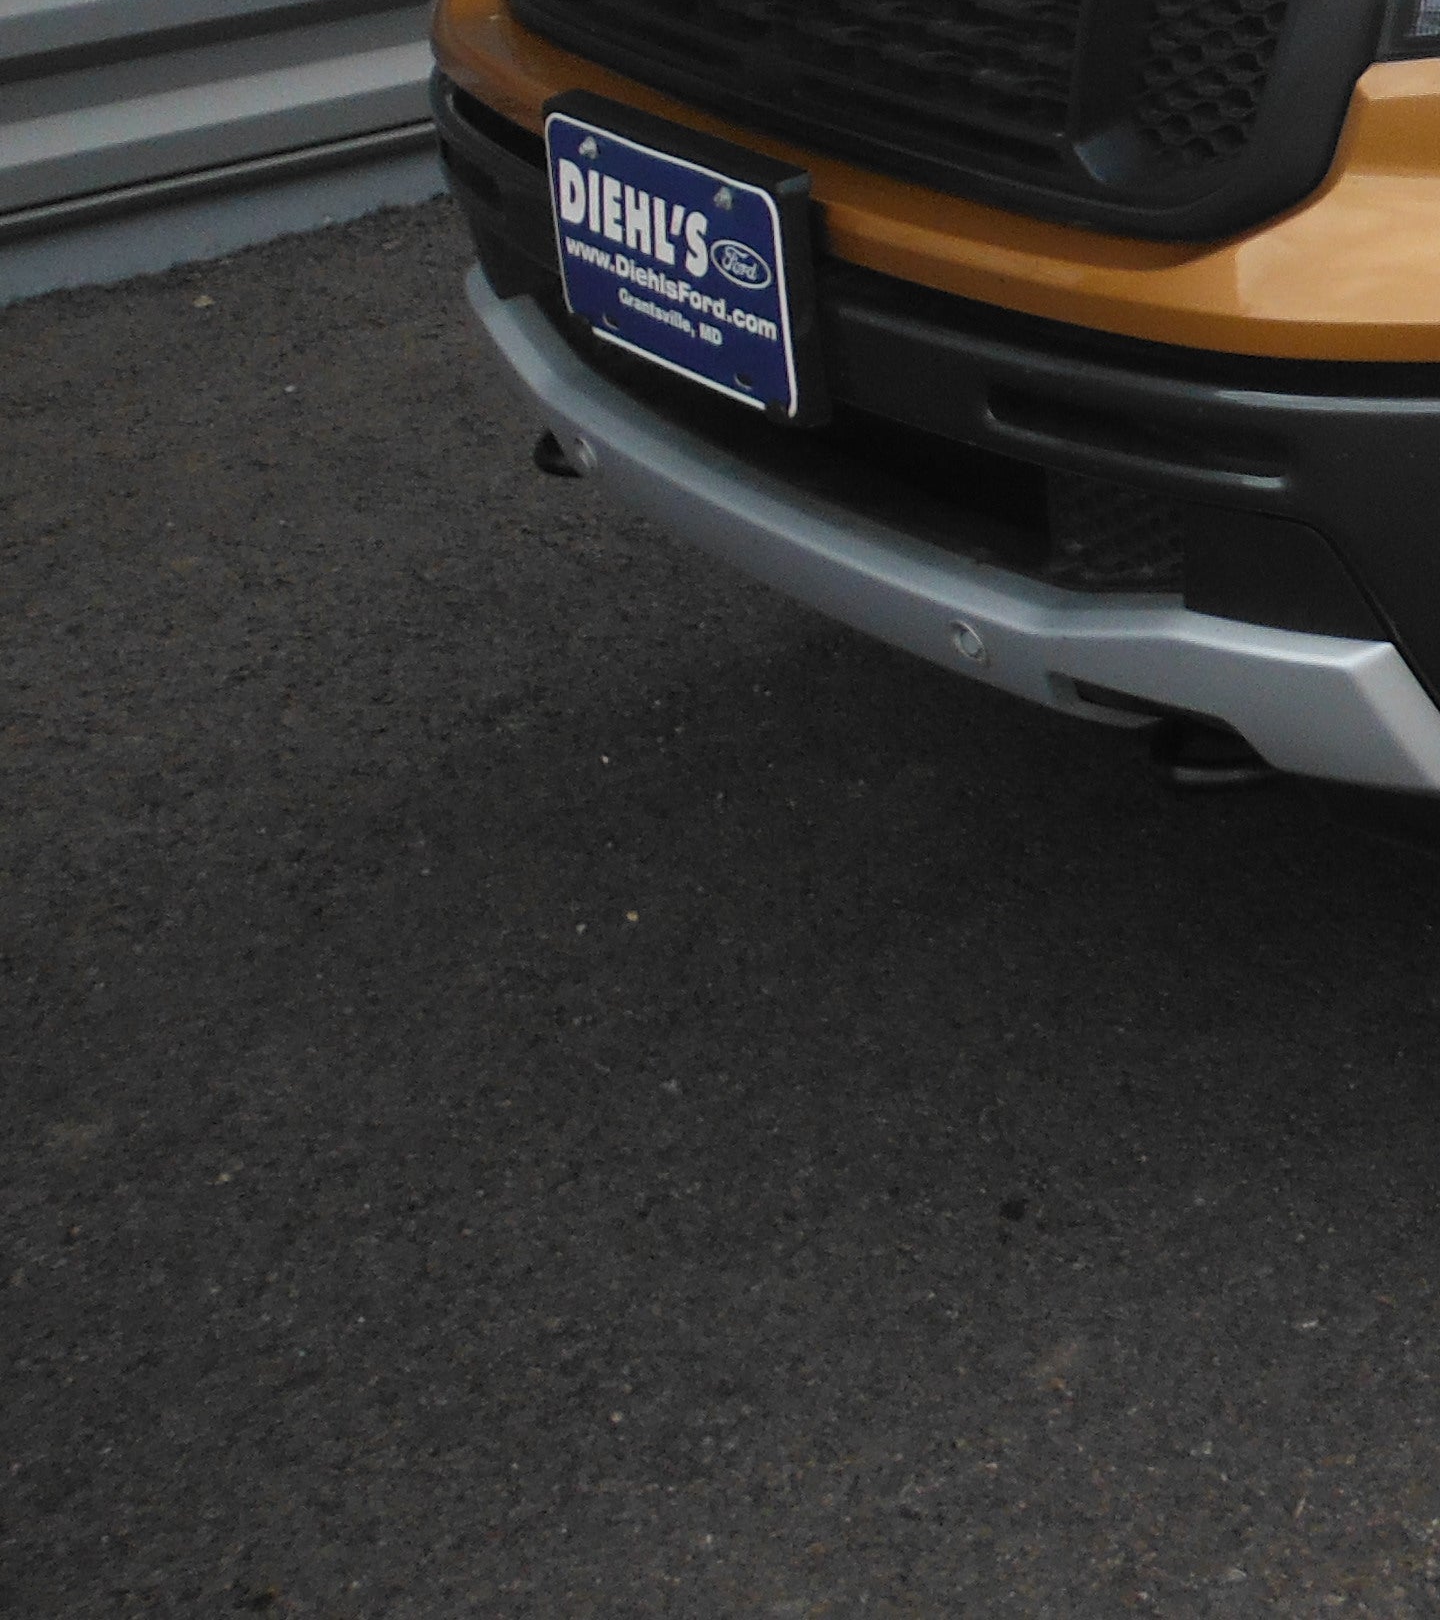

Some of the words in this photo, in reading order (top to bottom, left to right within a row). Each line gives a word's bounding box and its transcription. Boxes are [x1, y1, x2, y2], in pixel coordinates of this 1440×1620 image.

[557, 158, 709, 278] DIEHL'S
[564, 235, 778, 342] www.DiehlsFord.com
[698, 321, 724, 346] MD
